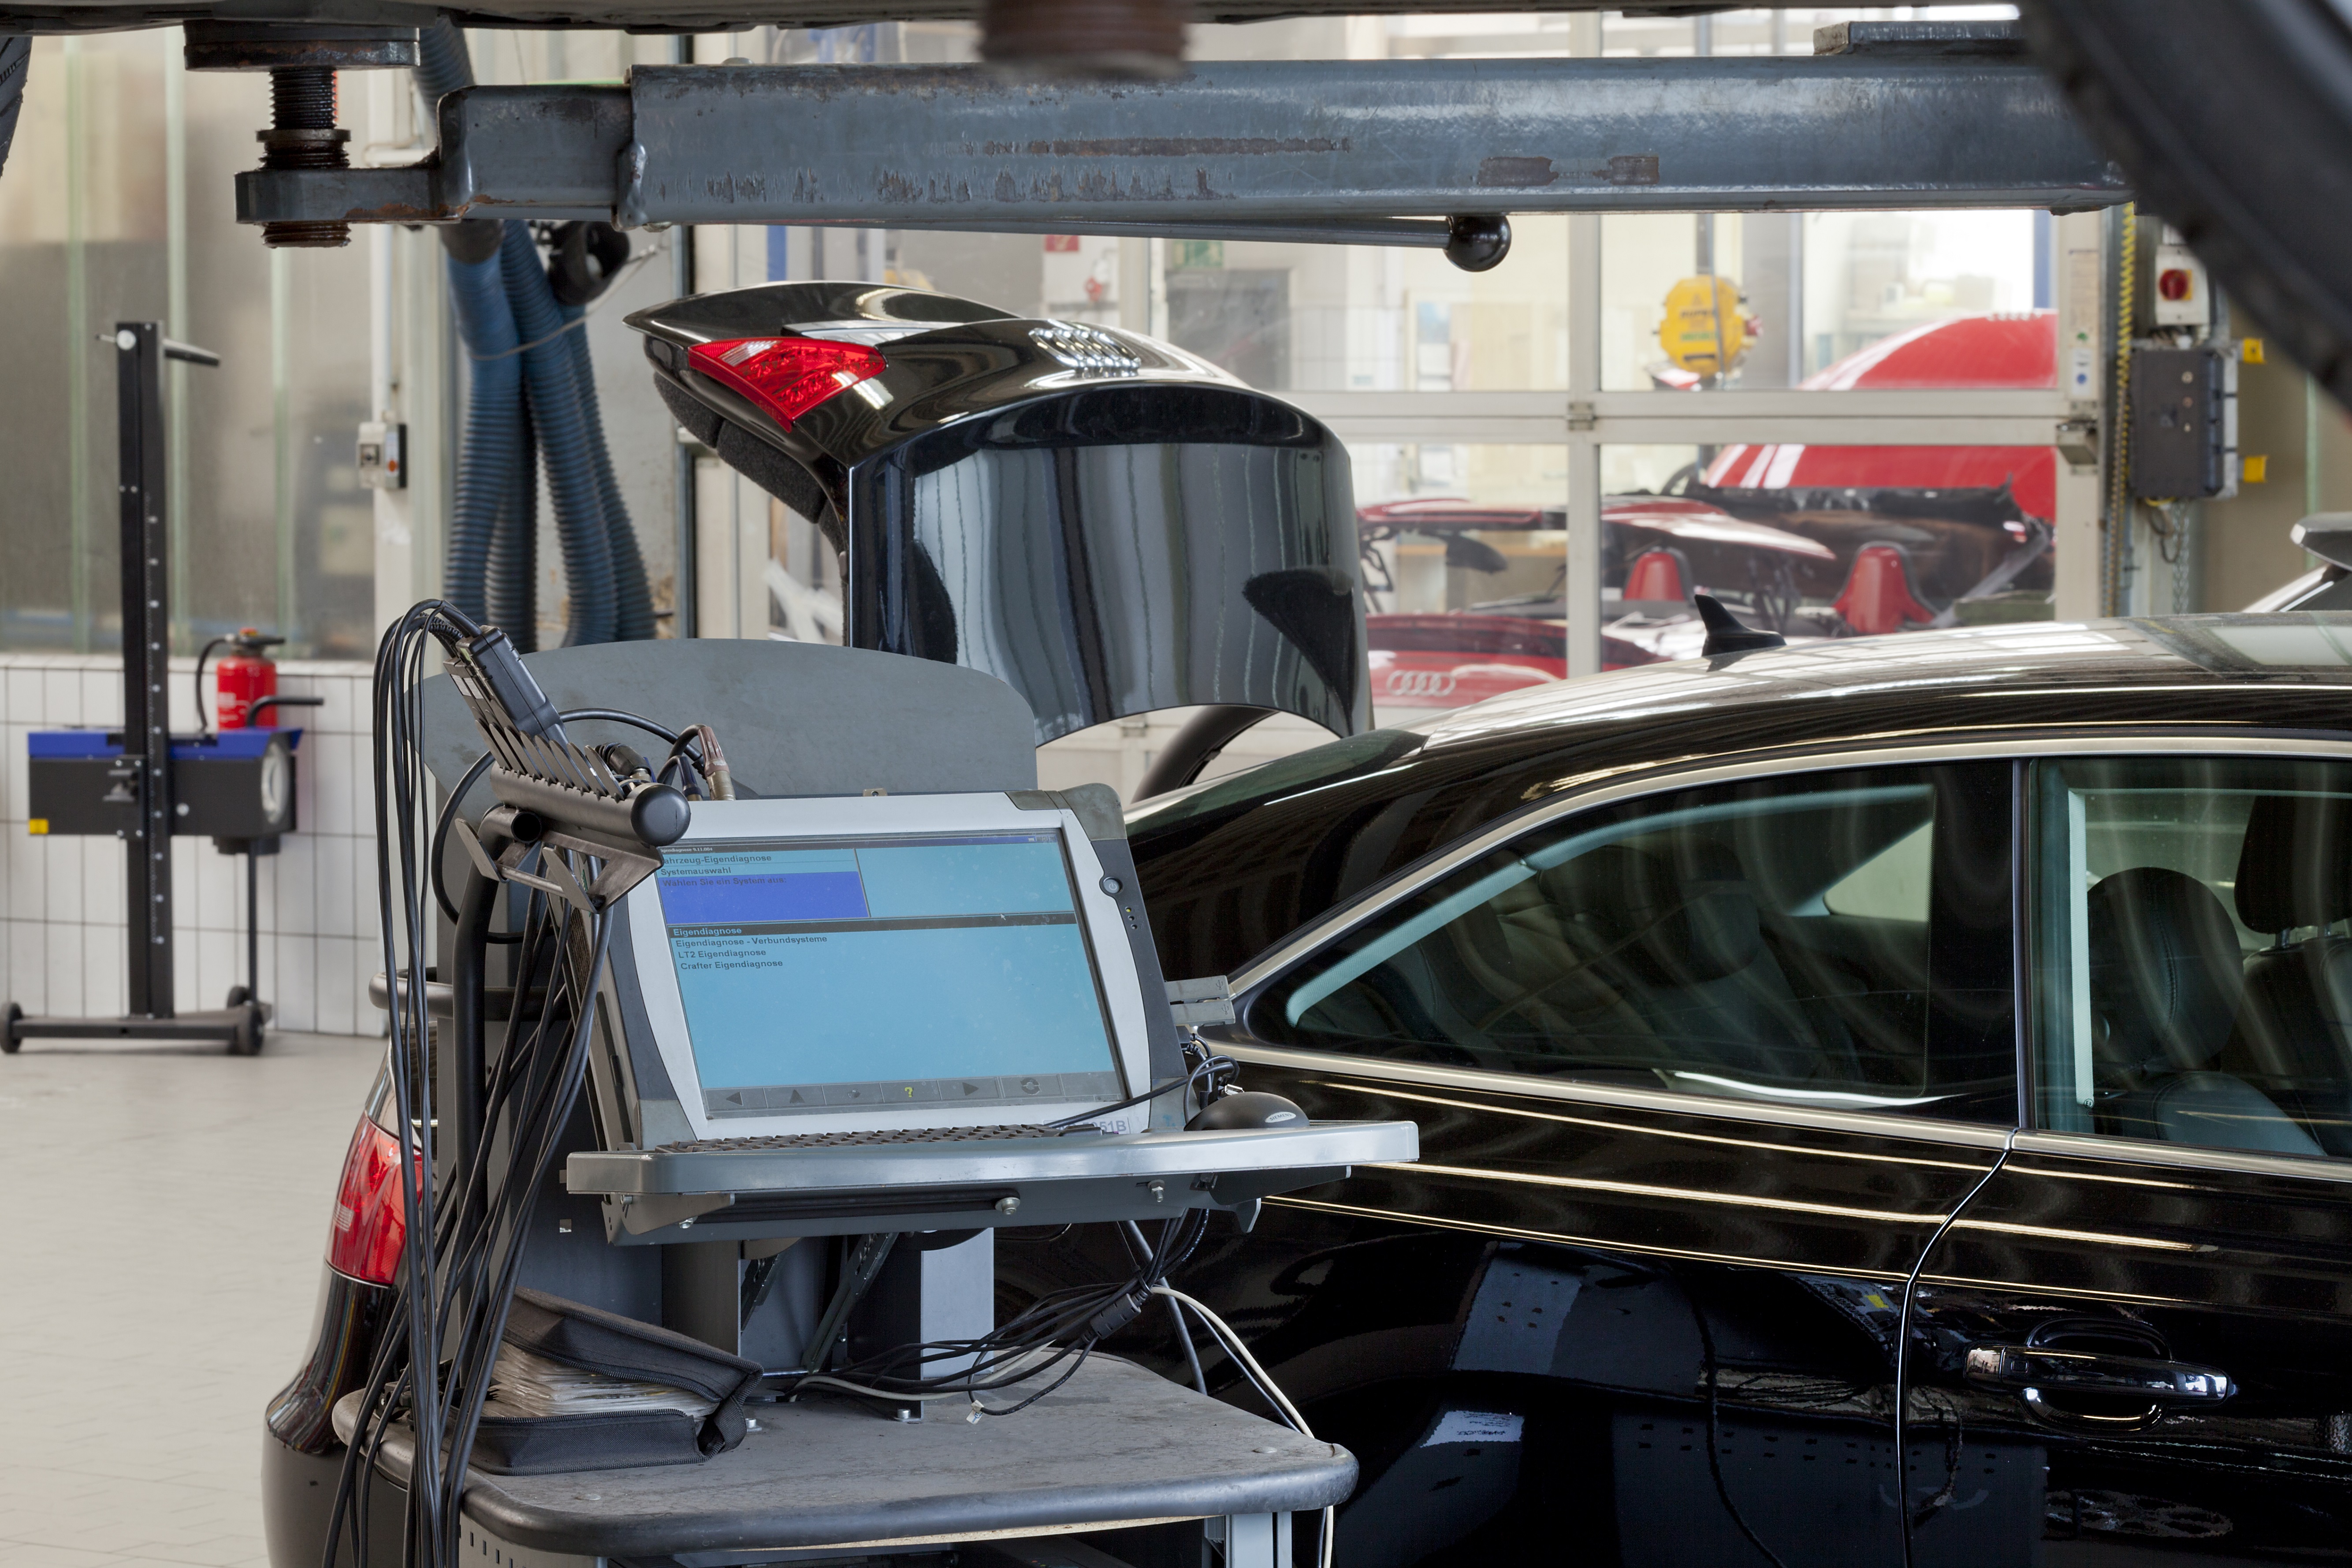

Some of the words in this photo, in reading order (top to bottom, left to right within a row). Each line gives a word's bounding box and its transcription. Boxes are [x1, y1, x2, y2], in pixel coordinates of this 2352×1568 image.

[664, 855, 771, 865] ahrzeug-Eigendiagnose
[661, 867, 731, 876] Systemauswahl
[733, 877, 766, 886] System
[673, 928, 742, 937] Eigendiagnose
[676, 939, 744, 948] Eigendiagnose
[751, 936, 827, 945] Verbundsysteme
[698, 949, 766, 959] Eigendiagnose
[715, 960, 783, 969] Eigendiagnose
